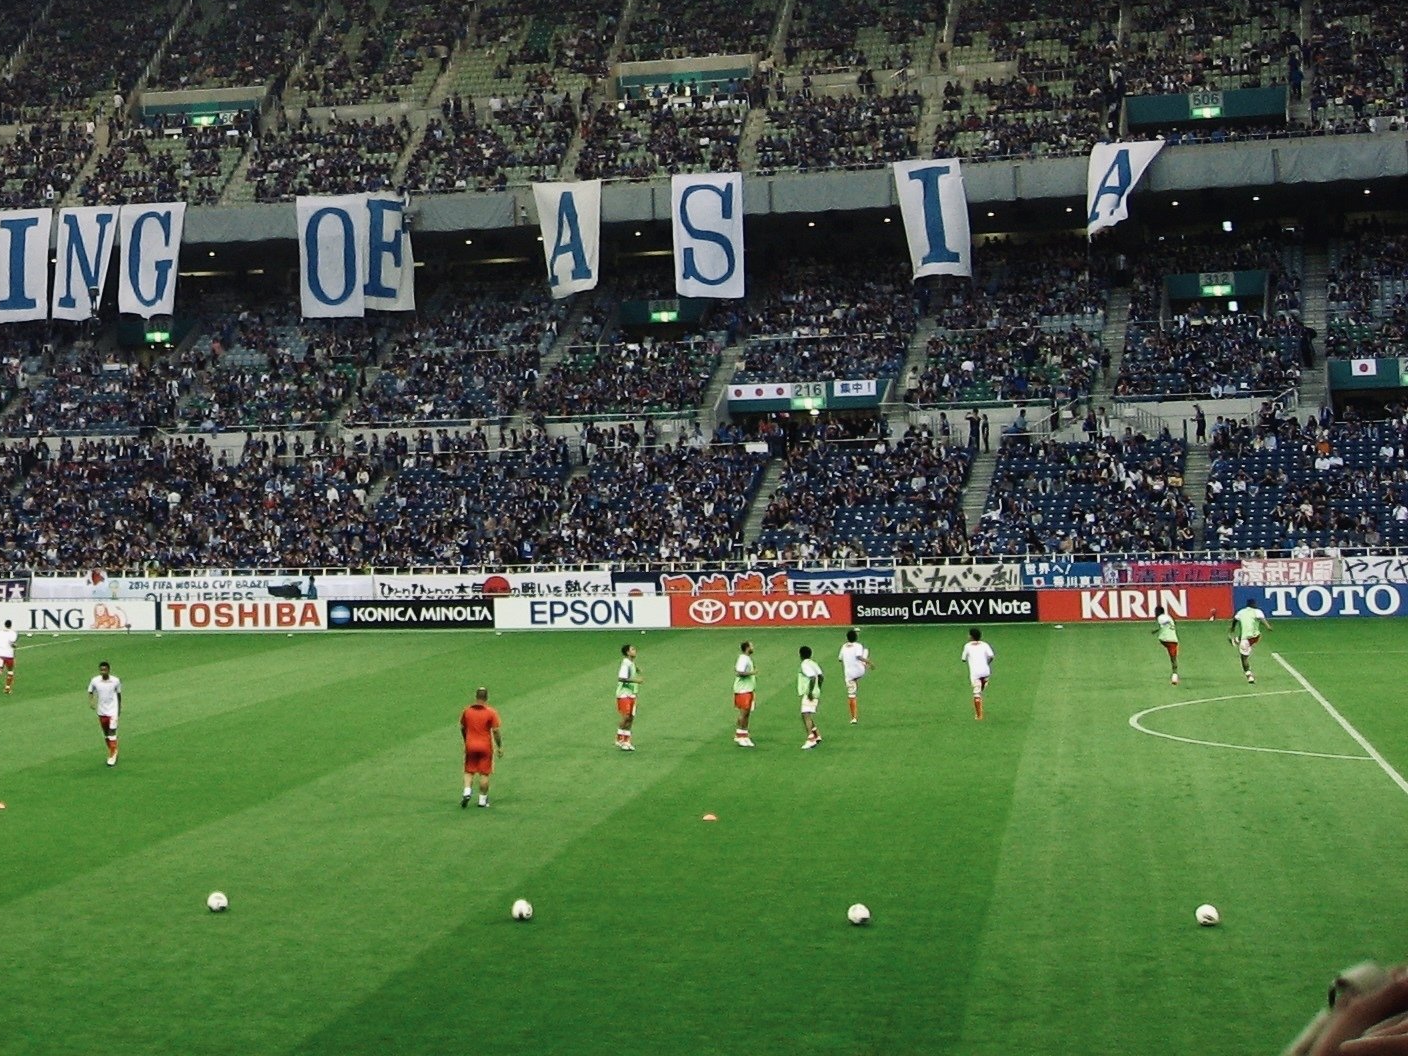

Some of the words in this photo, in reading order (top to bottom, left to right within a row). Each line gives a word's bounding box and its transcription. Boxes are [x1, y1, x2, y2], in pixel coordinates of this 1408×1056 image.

[794, 384, 822, 397] 216
[153, 580, 172, 590] FIFA
[175, 580, 209, 590] WORLD
[213, 580, 232, 589] CUP
[729, 600, 830, 620] TOYOTA
[857, 605, 909, 620] Samsung
[912, 599, 984, 616] GALAXY
[988, 599, 1032, 615] Note
[1080, 589, 1188, 619] KIRIN
[1264, 585, 1401, 616] TOTO
[29, 608, 85, 630] ING
[167, 602, 321, 628] TOSHIBA
[353, 606, 417, 622] KONICA
[420, 606, 493, 622] MINOLTA
[530, 600, 634, 625] EPSON
